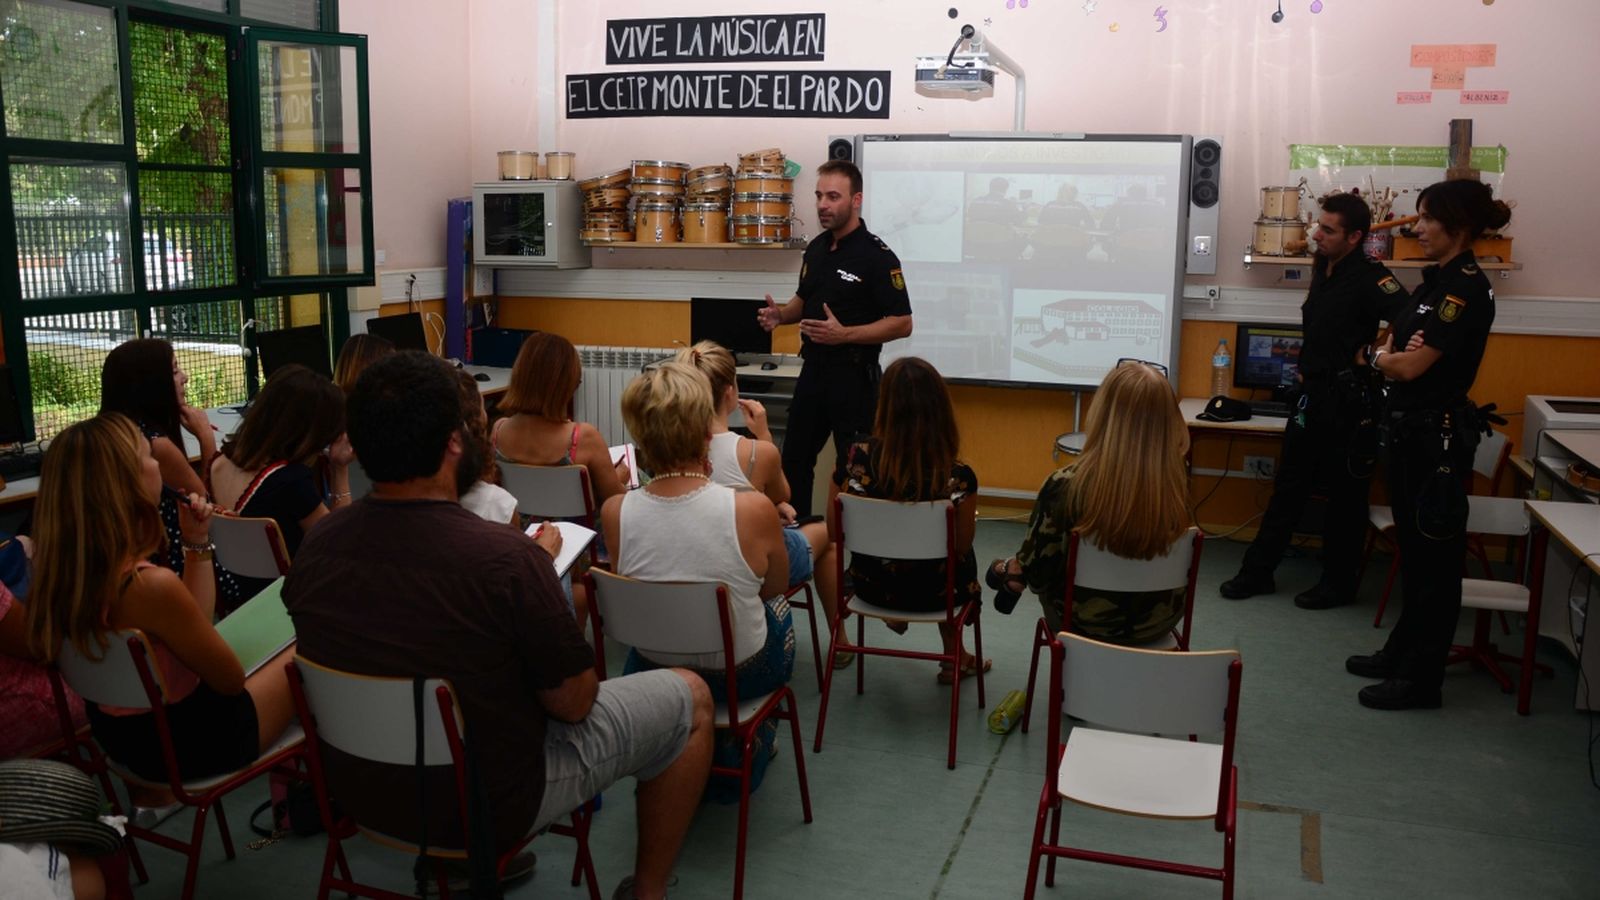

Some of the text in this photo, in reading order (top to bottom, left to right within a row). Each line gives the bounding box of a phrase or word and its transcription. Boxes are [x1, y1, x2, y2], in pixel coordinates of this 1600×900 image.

[609, 18, 824, 59] VIVE LA MÚSICA EN
[567, 74, 884, 112] EL CEIP MONTE DE EL PARDO
